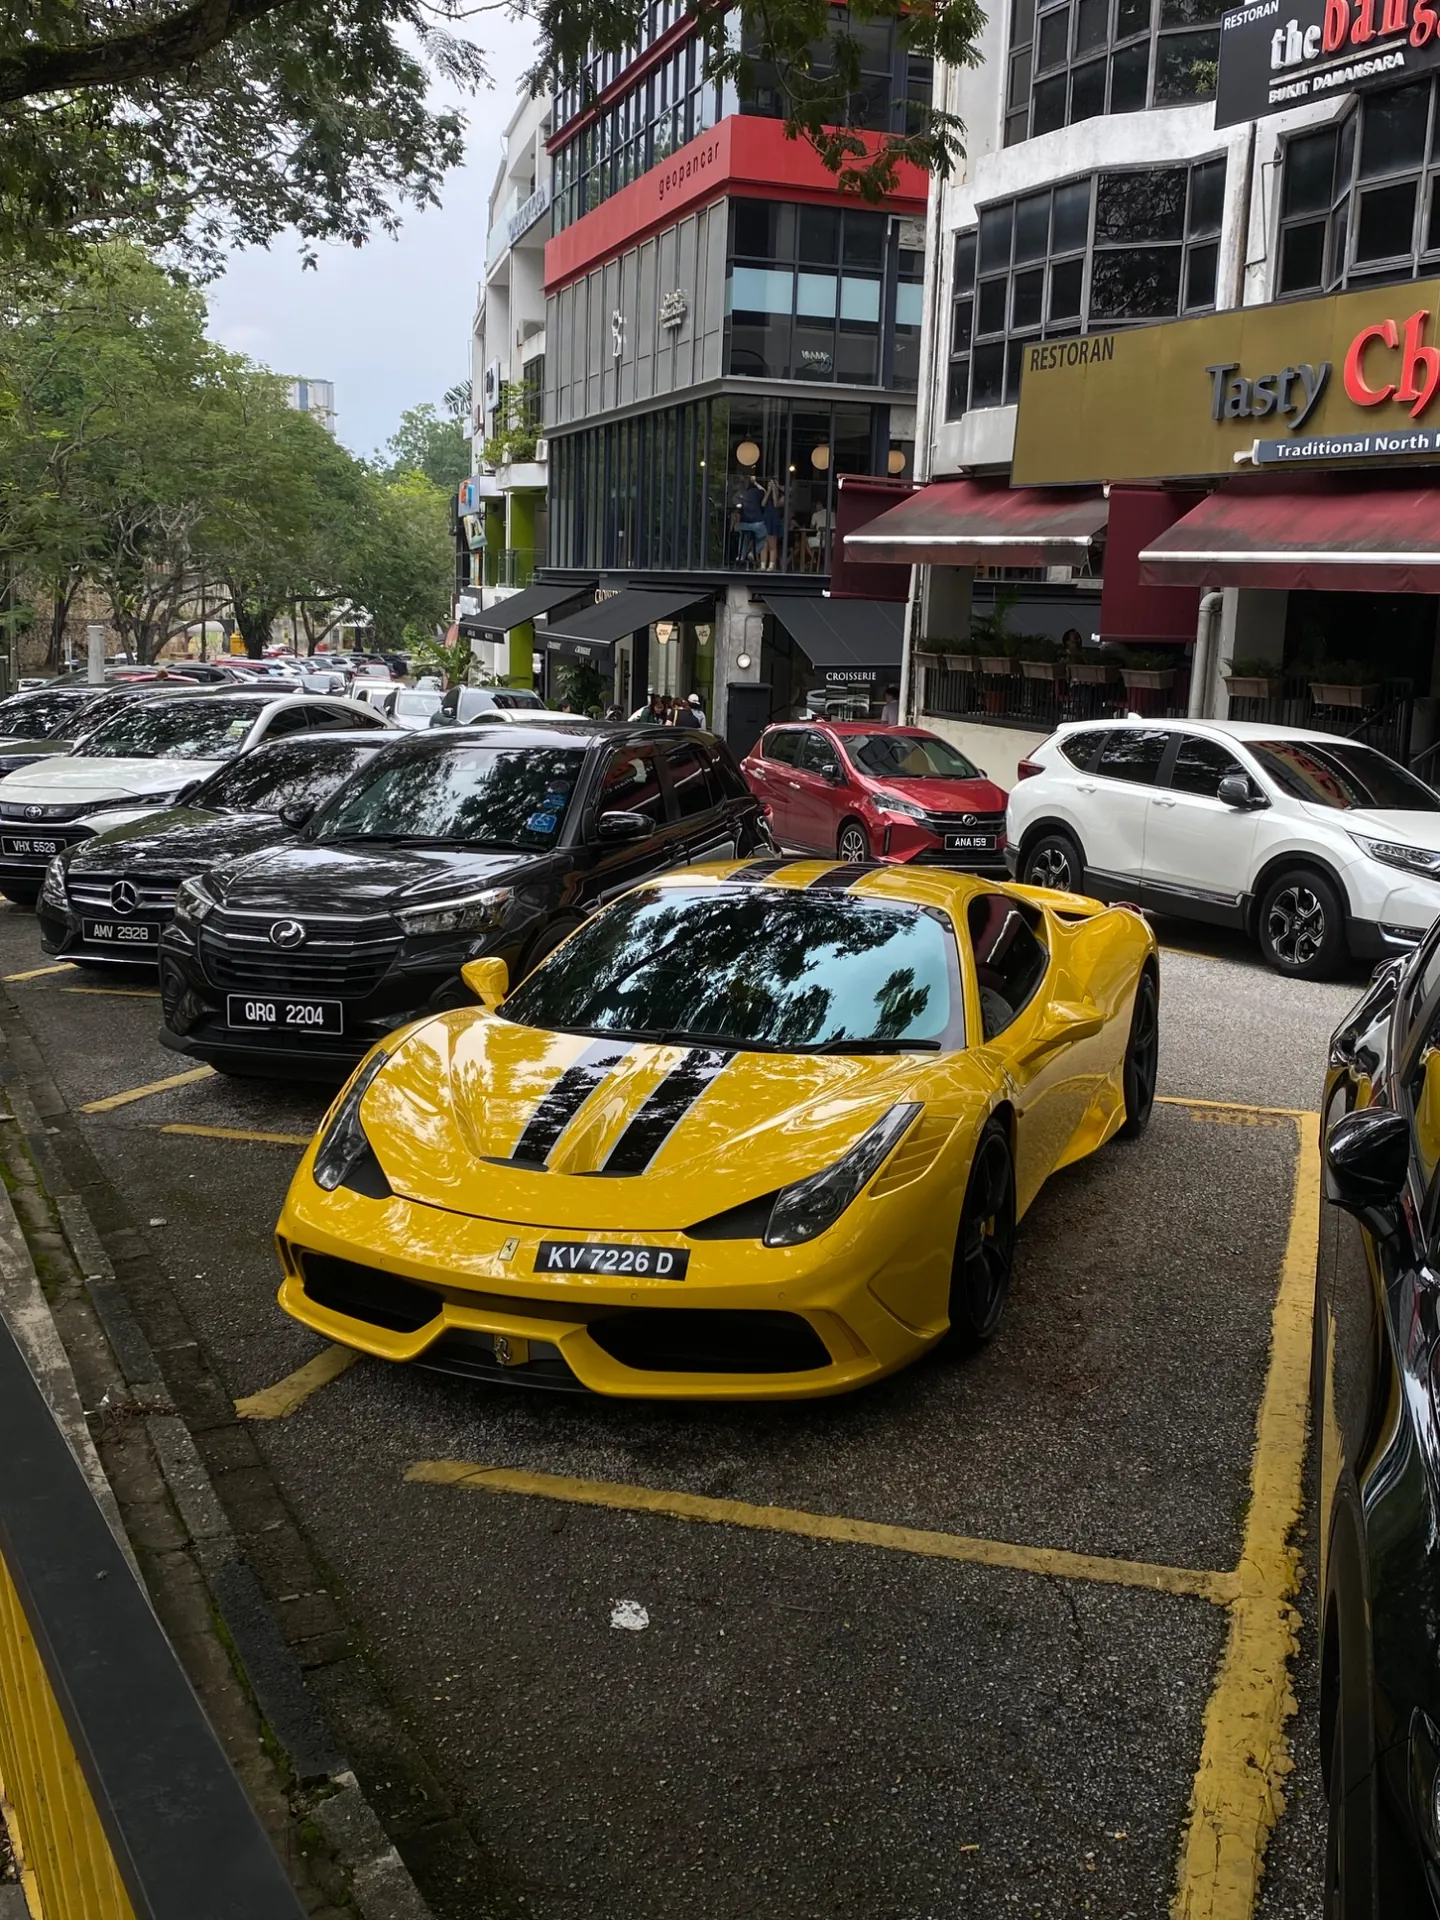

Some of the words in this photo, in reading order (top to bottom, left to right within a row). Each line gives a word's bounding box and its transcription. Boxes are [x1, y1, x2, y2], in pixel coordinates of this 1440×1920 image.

[1223, 0, 1280, 30] RESTORAN
[1268, 80, 1311, 104] BUKIT
[1312, 52, 1405, 91] DAMANSARA
[659, 141, 719, 201] geopancar
[1030, 336, 1115, 372] RESTORAN
[1205, 361, 1332, 430] Tasty
[1276, 438, 1370, 457] Traditional
[1375, 433, 1429, 451] North
[825, 671, 877, 681] CROISSERIE
[12, 840, 31, 852] VHX
[33, 841, 56, 853] 5528
[954, 837, 972, 847] ANA
[972, 837, 987, 847] 159
[93, 923, 114, 938] AMV
[117, 926, 149, 940] 2928
[245, 1002, 276, 1022] QRQ
[285, 1004, 324, 1025] 2204
[547, 1246, 585, 1269] KV
[589, 1249, 650, 1273] 7226
[656, 1252, 674, 1274] D
